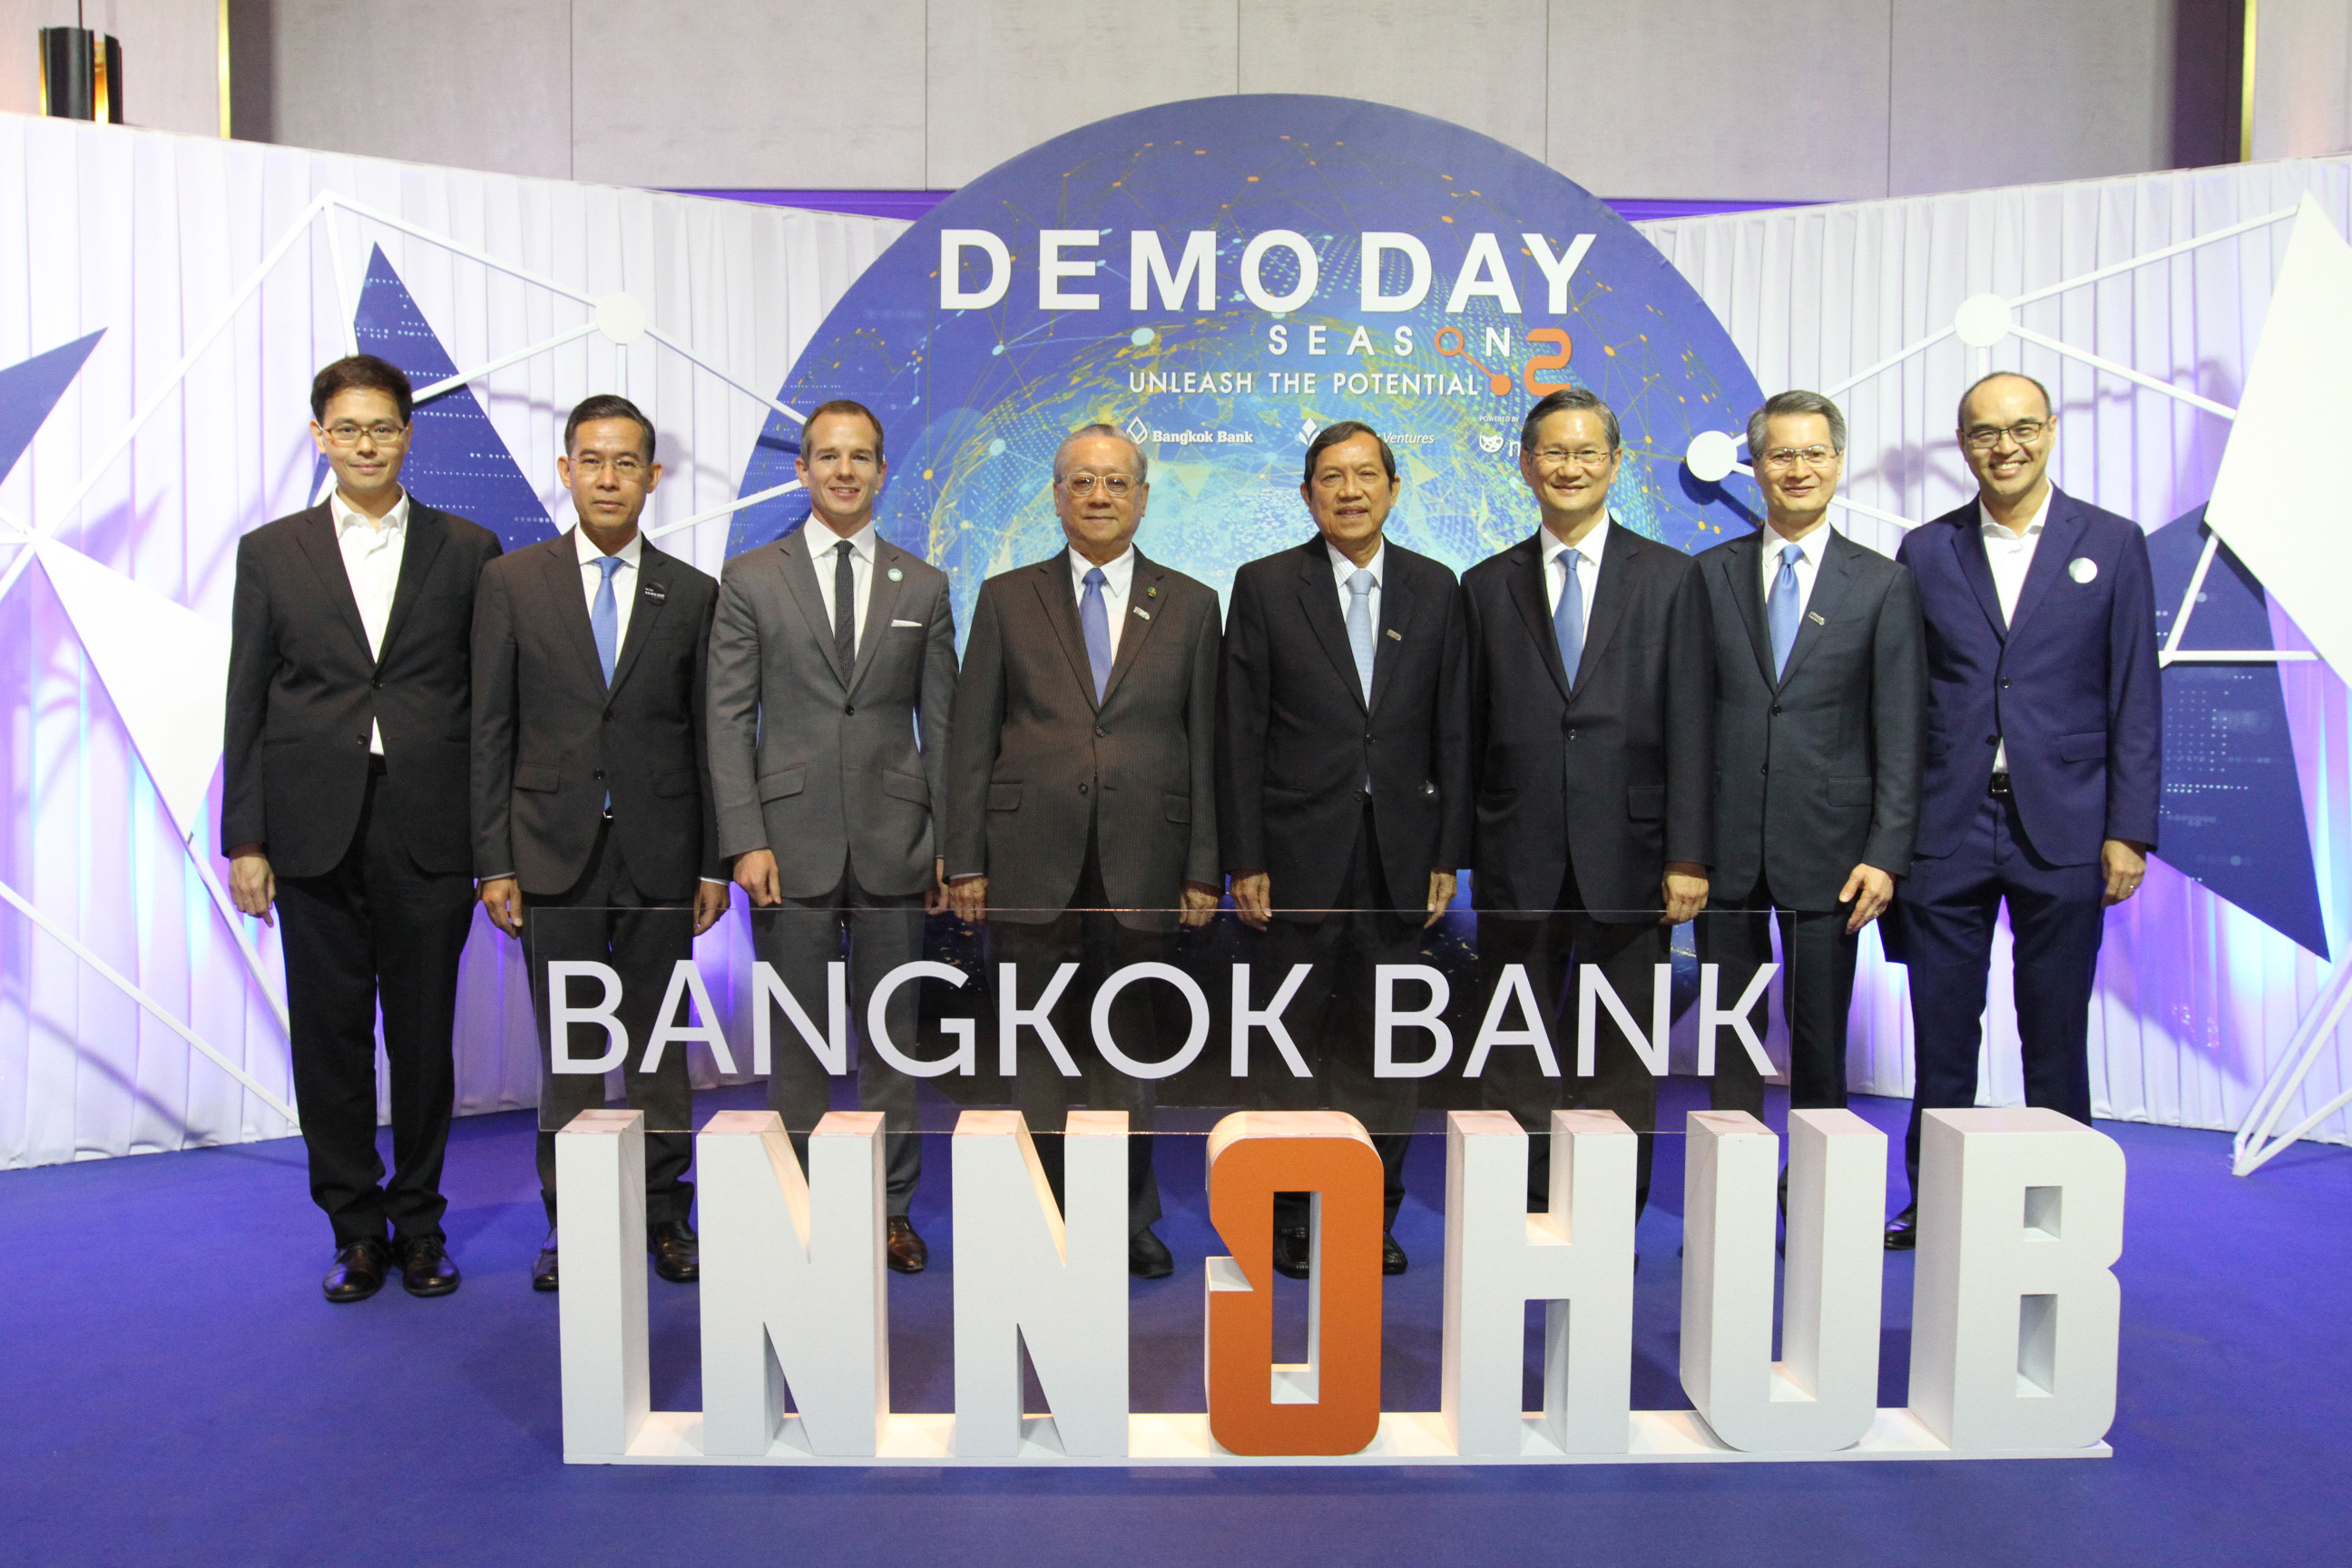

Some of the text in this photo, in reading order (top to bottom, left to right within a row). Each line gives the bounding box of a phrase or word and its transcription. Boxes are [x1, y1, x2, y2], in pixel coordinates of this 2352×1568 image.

[939, 229, 1596, 315] DEMO DAY
[1129, 370, 1479, 397] UNLEASH THE POTENTIAL
[1268, 324, 1573, 397] SEASON 2
[1152, 429, 1254, 446] Bangkok Bank
[1383, 432, 1435, 444] Ventures
[547, 959, 1781, 1079] BANGKOK BANK
[555, 1107, 2127, 1458] INNOHUB
